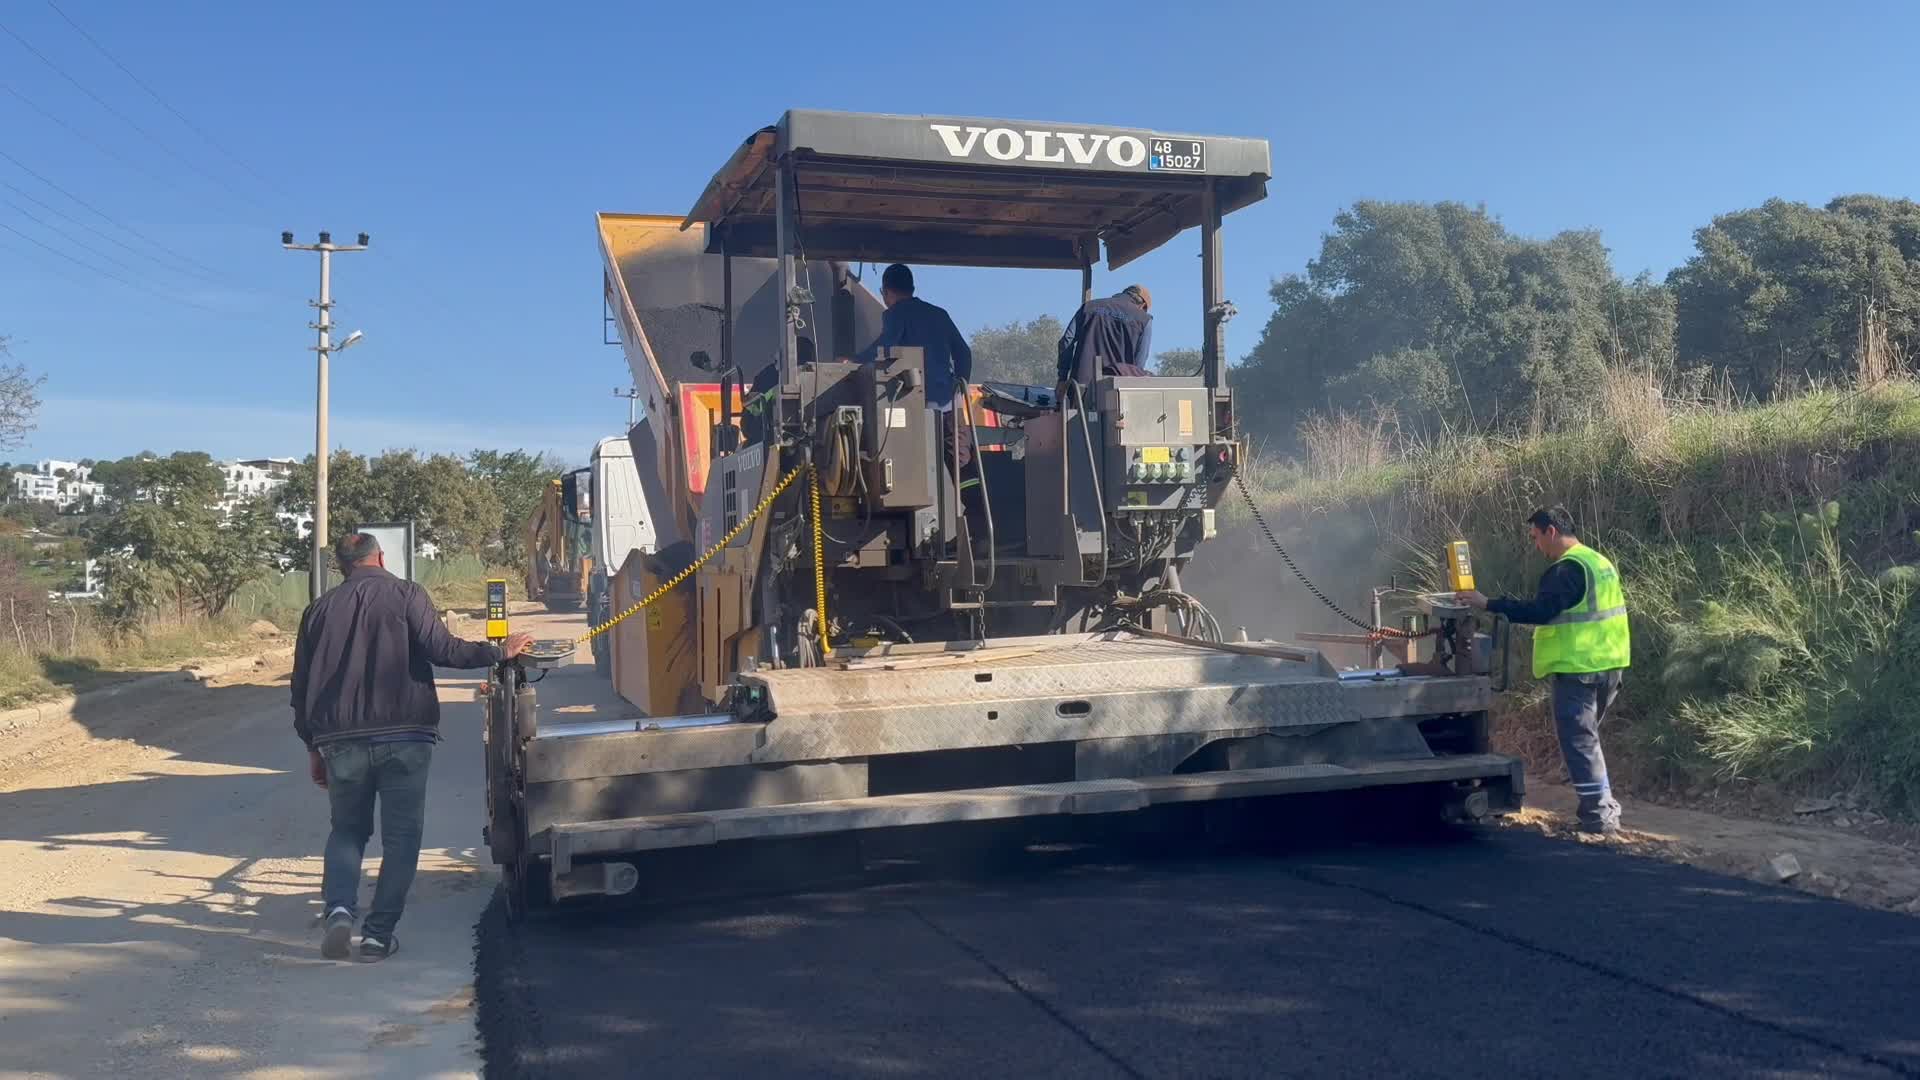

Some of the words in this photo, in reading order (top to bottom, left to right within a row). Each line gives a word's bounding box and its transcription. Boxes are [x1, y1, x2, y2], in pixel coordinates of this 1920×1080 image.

[930, 124, 1146, 167] VOLVO
[1154, 141, 1171, 154] 48
[1192, 142, 1201, 156] D
[1159, 155, 1201, 168] 15027
[737, 448, 761, 472] VOLVO
